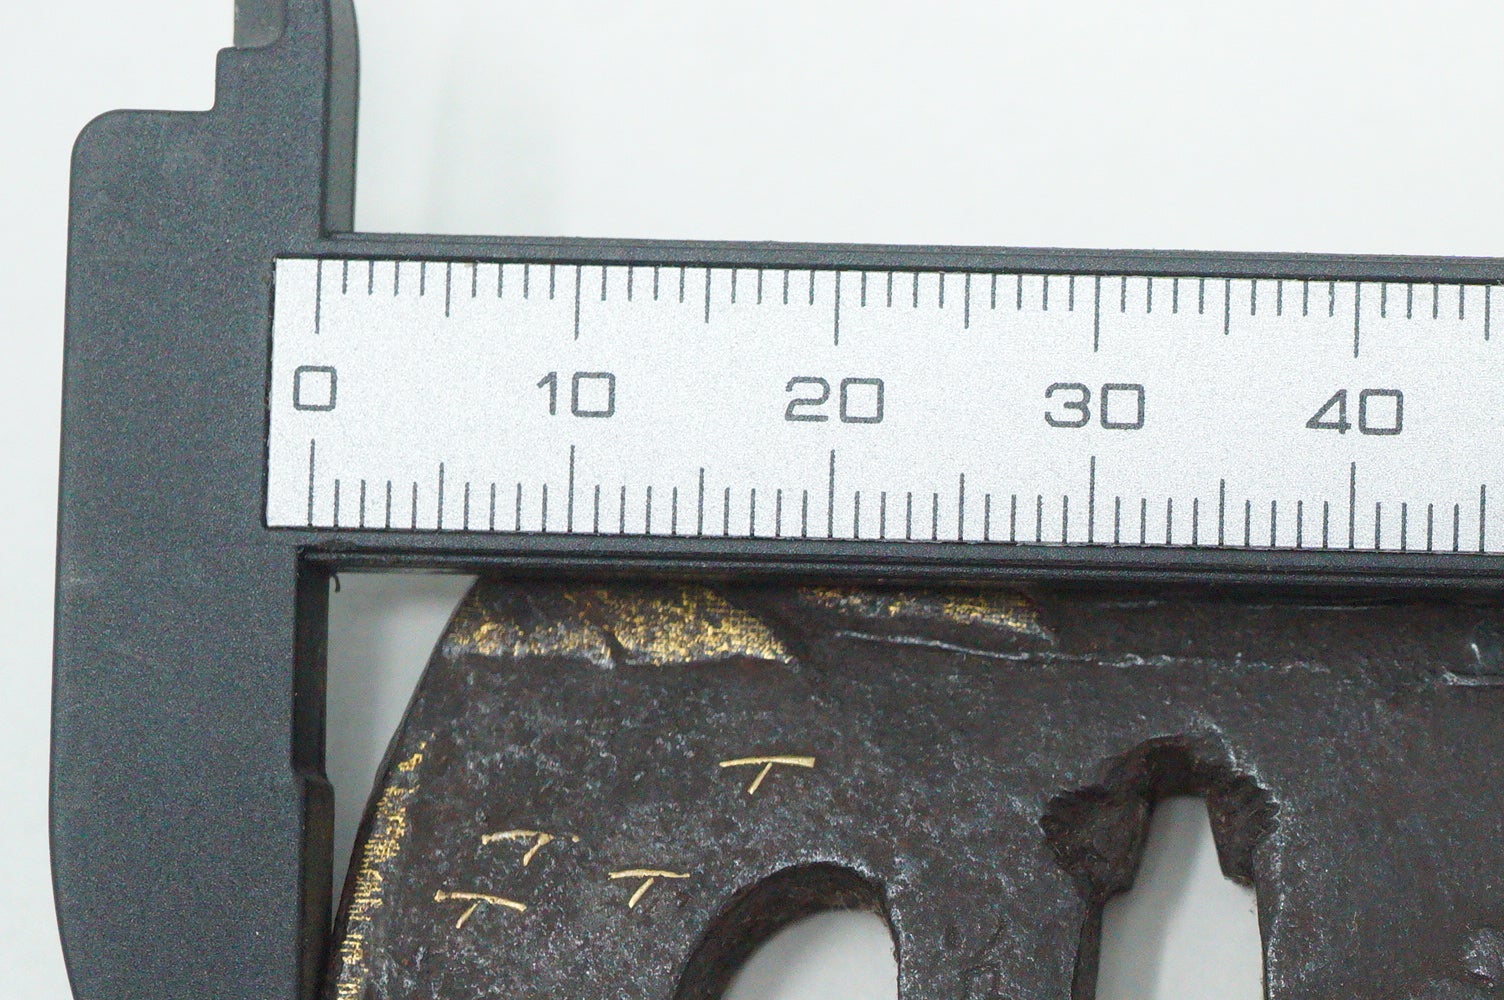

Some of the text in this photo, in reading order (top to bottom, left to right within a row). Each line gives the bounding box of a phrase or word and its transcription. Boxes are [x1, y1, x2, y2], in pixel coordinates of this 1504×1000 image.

[292, 365, 338, 412] 0
[536, 371, 616, 418] 10
[784, 376, 885, 425] 20
[1044, 382, 1146, 430] 30
[1305, 387, 1405, 436] 40
